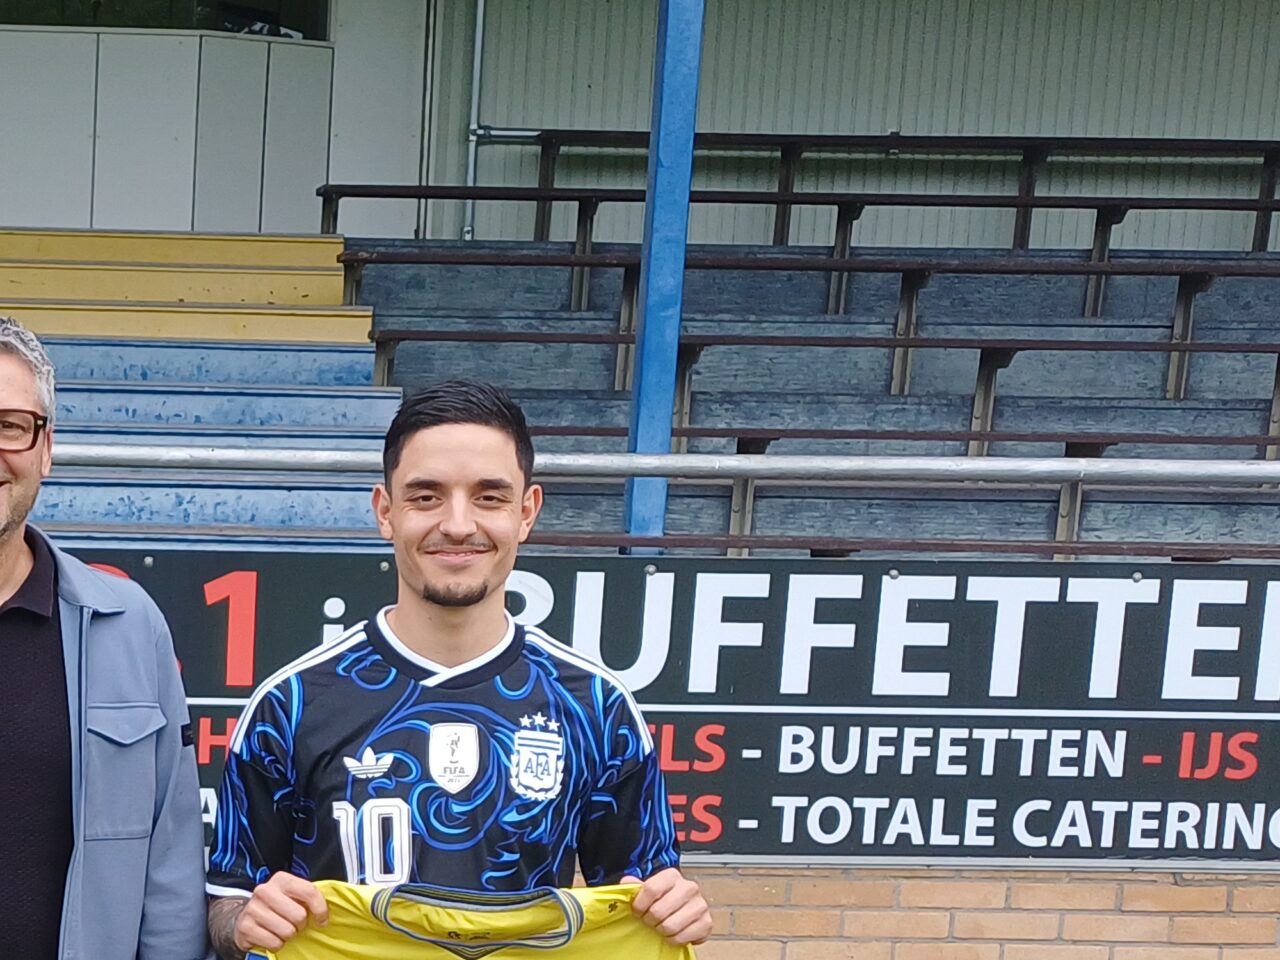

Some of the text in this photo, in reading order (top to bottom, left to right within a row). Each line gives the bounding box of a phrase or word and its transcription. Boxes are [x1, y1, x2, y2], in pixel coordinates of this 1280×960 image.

[647, 722, 727, 773] LS
[778, 725, 1128, 779] BUFFETTEN
[1177, 731, 1260, 781] IJS
[332, 797, 413, 887] 10
[771, 796, 997, 847] TOTALE
